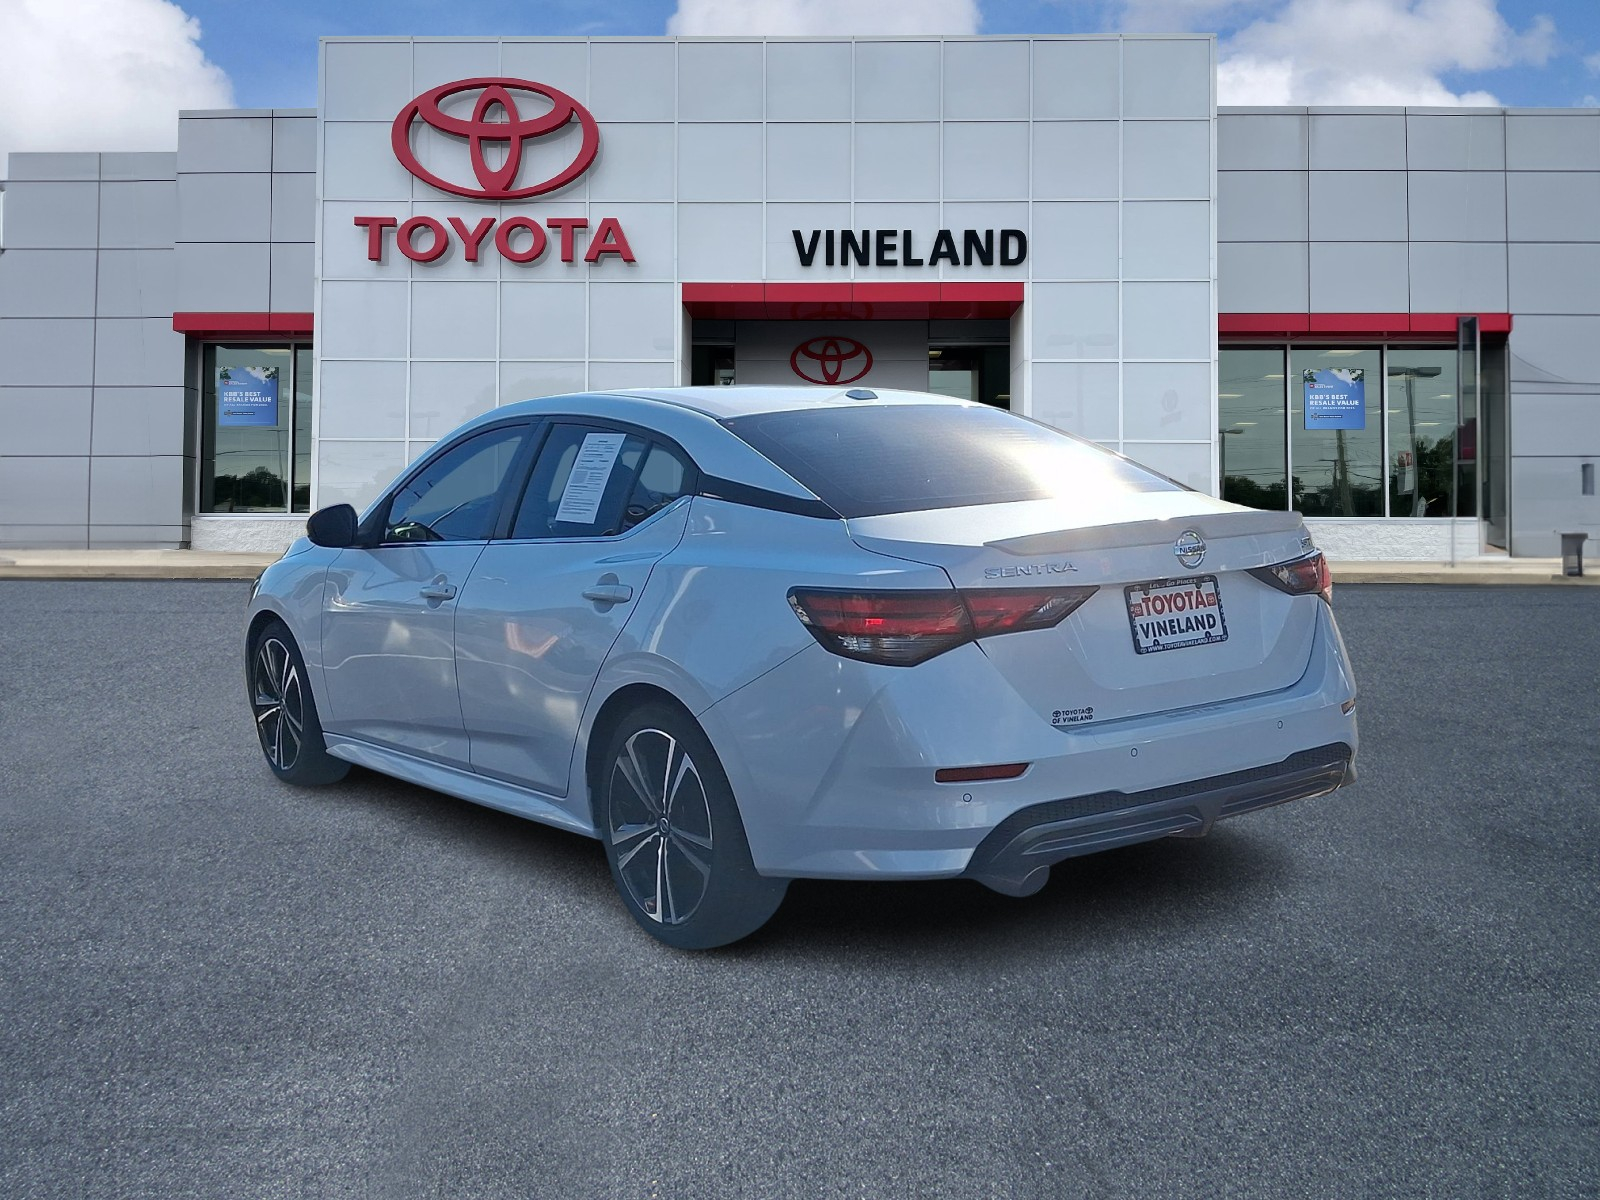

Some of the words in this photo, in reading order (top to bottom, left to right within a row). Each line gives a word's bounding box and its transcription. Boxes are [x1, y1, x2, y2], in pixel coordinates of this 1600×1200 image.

[354, 216, 636, 263] TOYOTA
[792, 229, 1028, 266] VINELAND
[1179, 544, 1206, 553] NISSAN
[984, 561, 1079, 580] SENTRA
[1141, 589, 1207, 616] TOYOTA
[1139, 613, 1217, 639] VINELAND
[1061, 708, 1085, 716] TOYOTA
[1062, 714, 1093, 723] VINELAND
